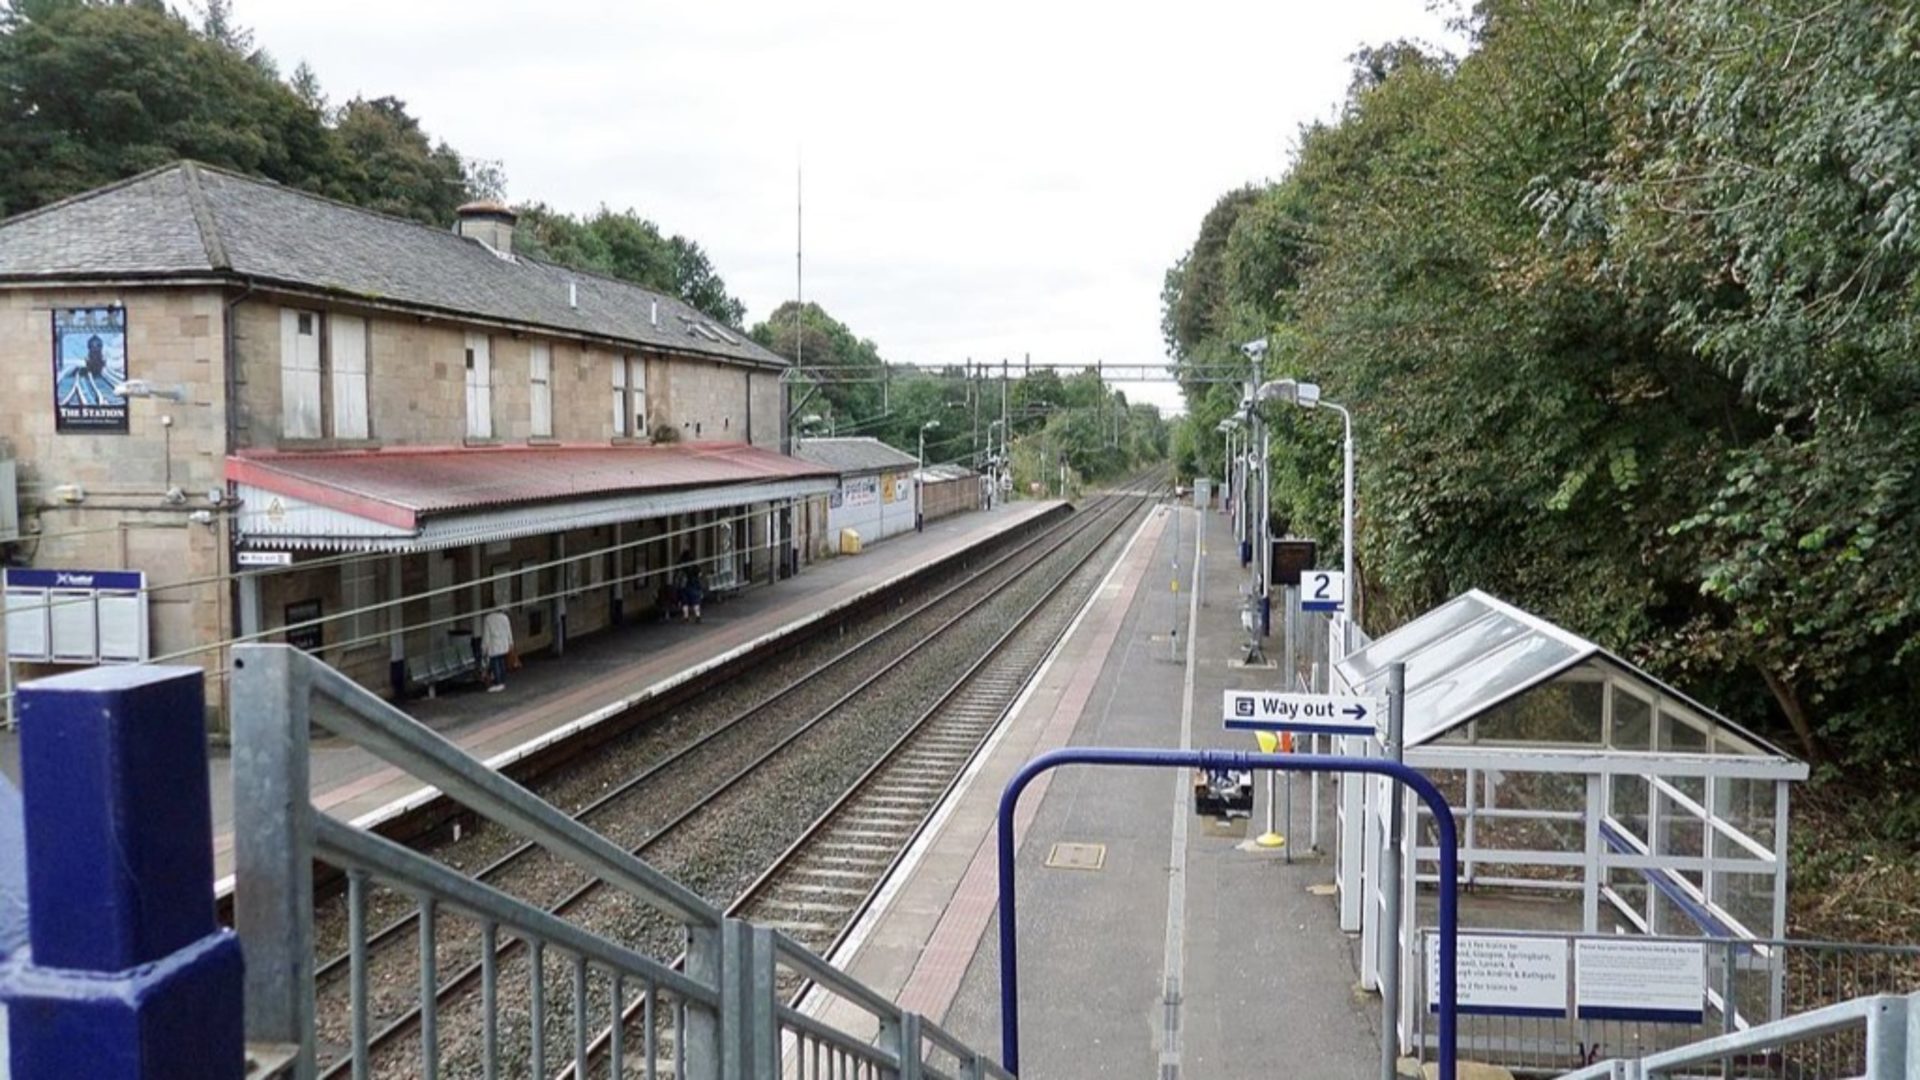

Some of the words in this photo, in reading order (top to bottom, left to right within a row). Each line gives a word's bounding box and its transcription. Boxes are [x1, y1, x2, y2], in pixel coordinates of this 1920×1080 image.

[1314, 574, 1330, 599] 2
[1262, 699, 1298, 719] Way
[1303, 701, 1335, 717] out
